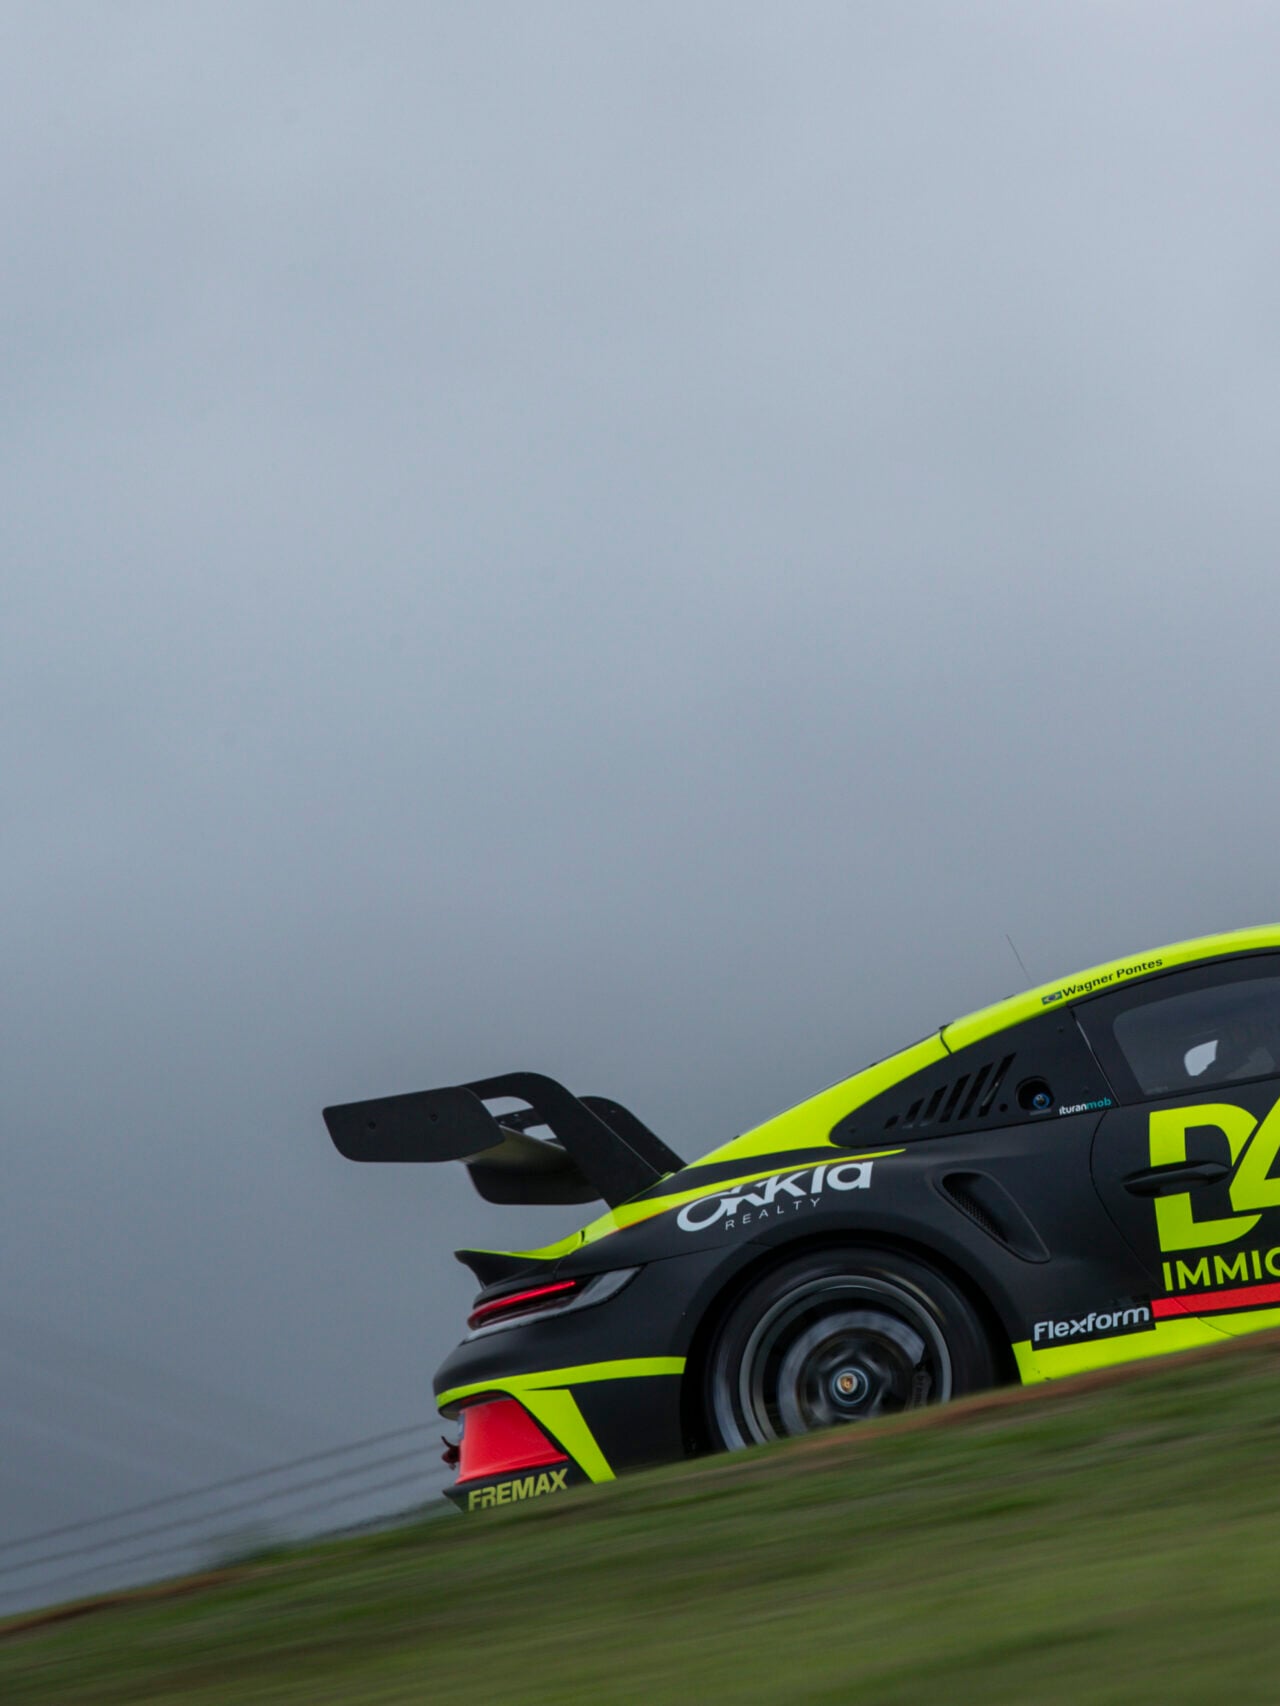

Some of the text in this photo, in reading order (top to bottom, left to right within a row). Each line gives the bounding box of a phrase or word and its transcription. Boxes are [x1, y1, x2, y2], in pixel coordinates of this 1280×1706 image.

[1062, 958, 1163, 997] Wagner Pontes
[1059, 1097, 1112, 1116] ituranmob
[725, 1198, 821, 1230] REALTY
[1033, 1306, 1150, 1342] Flexform
[468, 1468, 568, 1512] FREMAX
